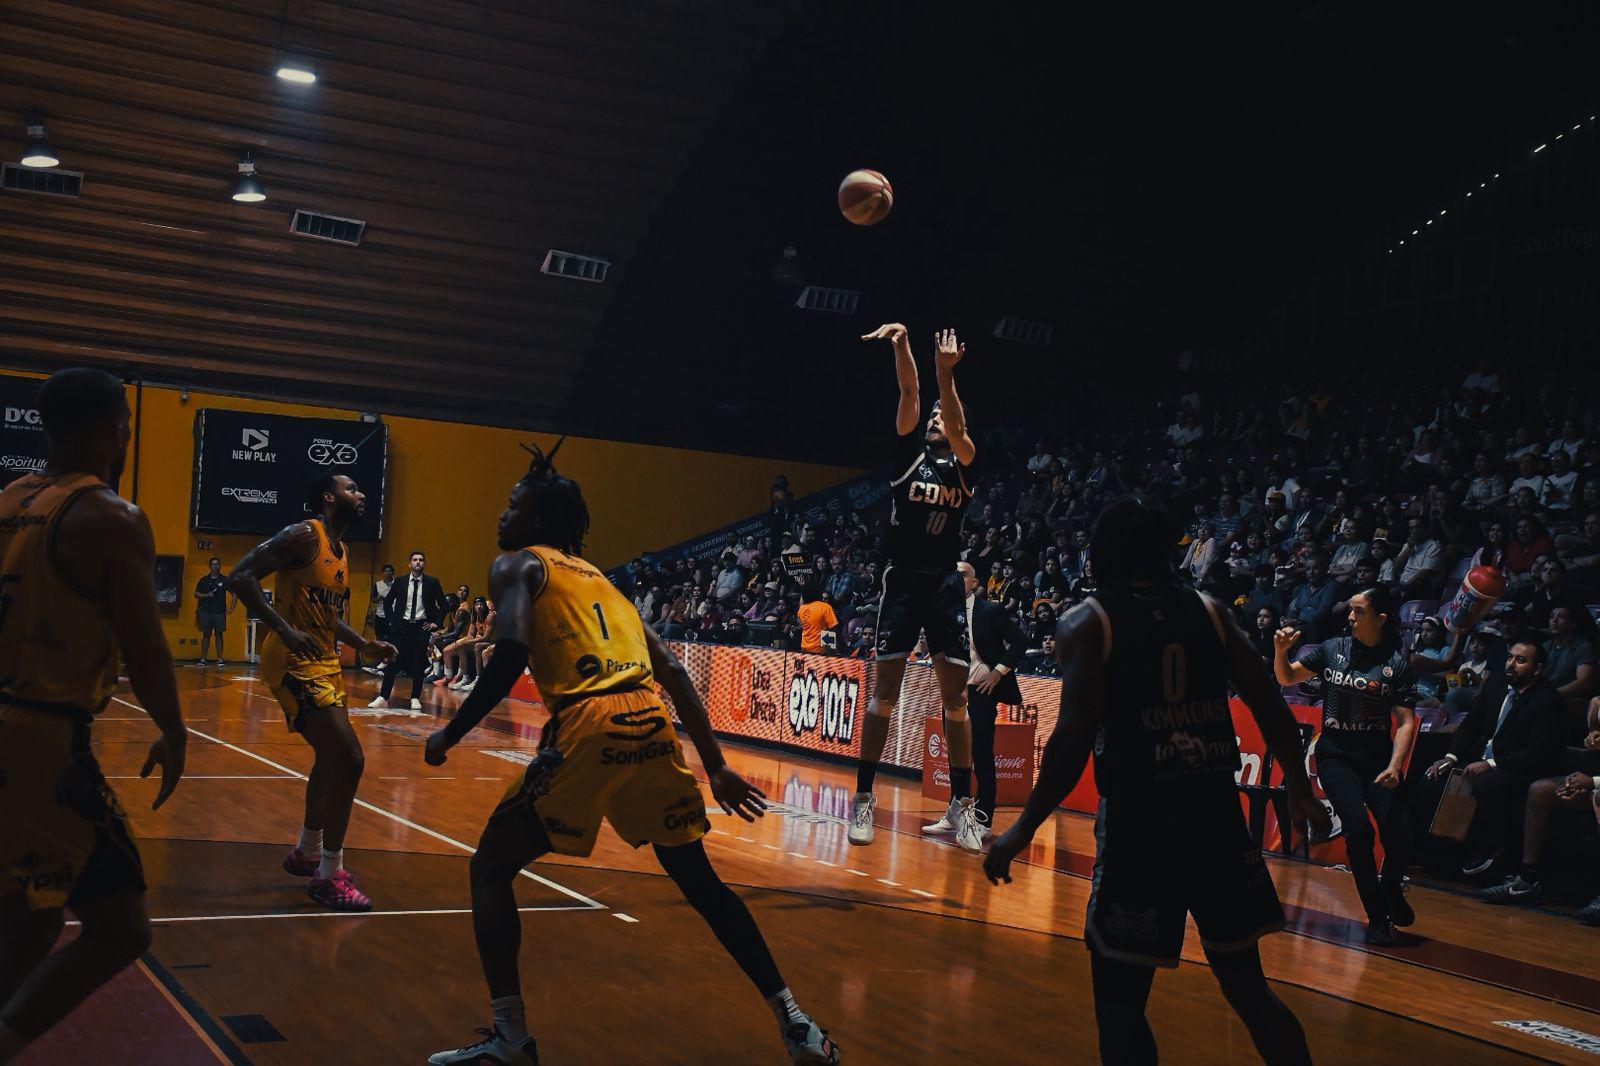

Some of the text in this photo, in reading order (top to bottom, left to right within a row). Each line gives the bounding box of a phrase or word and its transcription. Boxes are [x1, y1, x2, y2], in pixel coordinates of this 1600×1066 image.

[5, 407, 43, 424] D'G
[232, 450, 277, 463] NEW PLAY
[221, 487, 278, 501] EXTREME
[926, 510, 949, 536] 10
[592, 602, 609, 640] 1
[1162, 643, 1186, 702] 0
[789, 668, 820, 735] exa
[601, 740, 676, 765] SoniGas
[19, 863, 73, 893] ypsi
